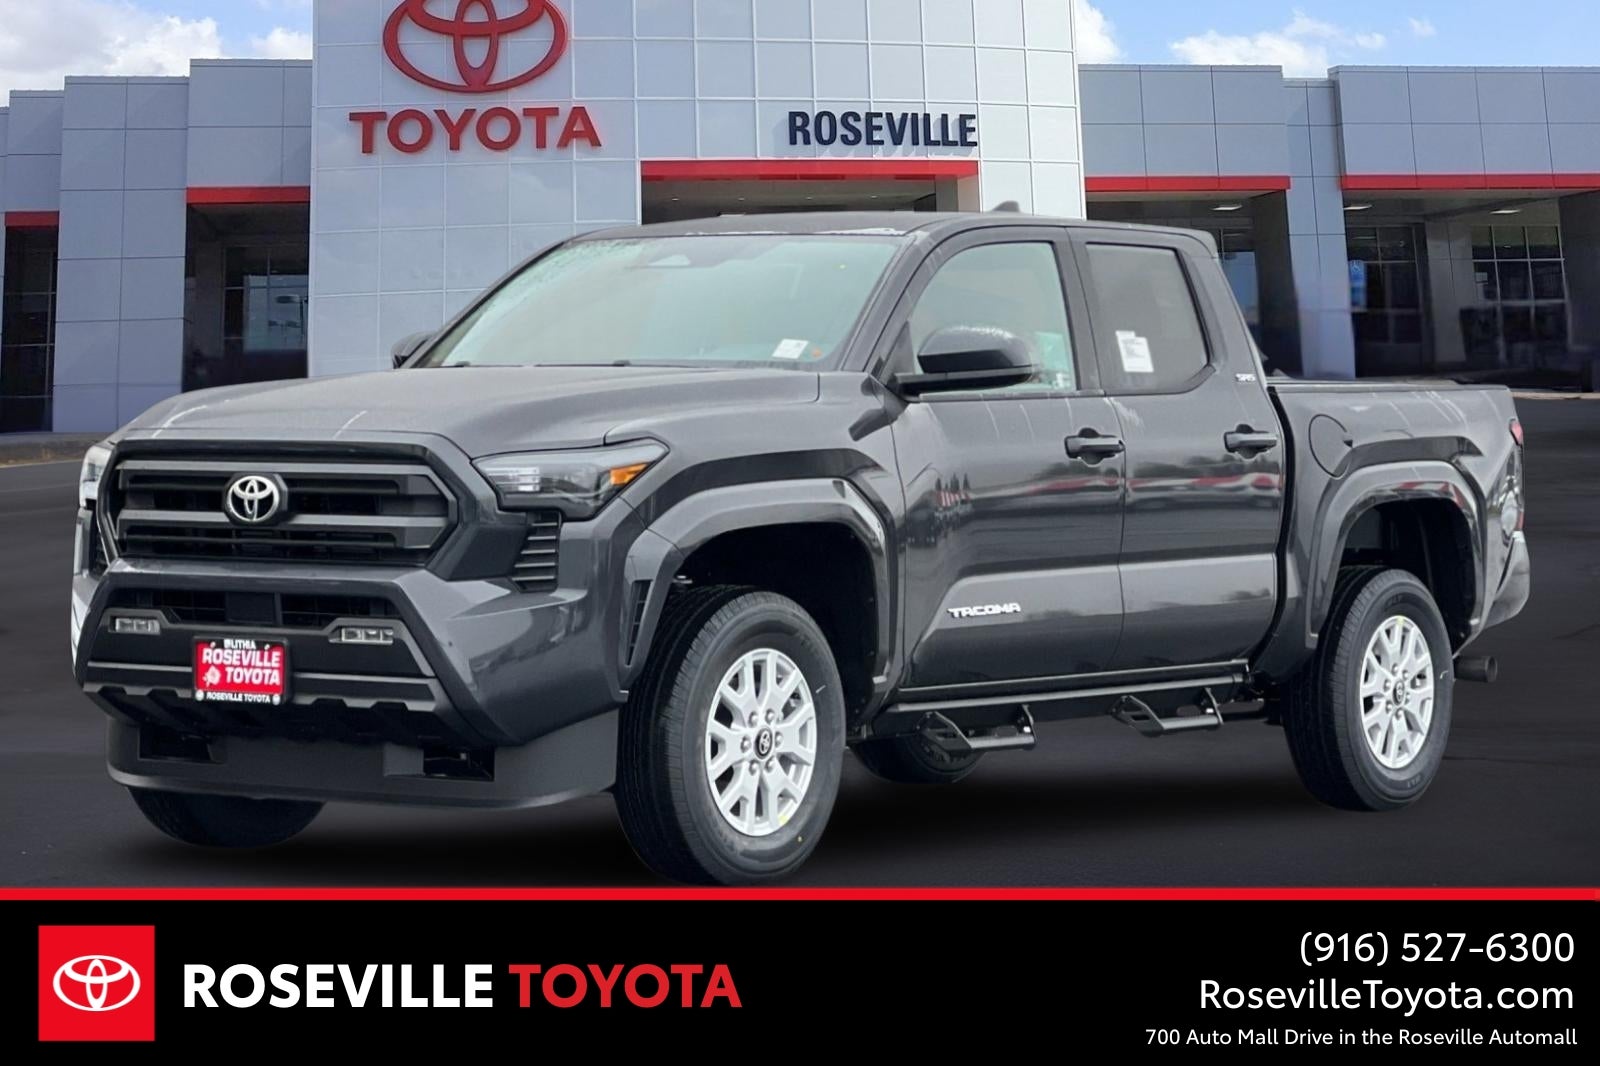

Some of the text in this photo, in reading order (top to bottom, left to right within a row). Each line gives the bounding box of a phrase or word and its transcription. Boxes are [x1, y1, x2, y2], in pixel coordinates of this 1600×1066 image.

[349, 106, 602, 154] TOYOTA
[788, 110, 978, 147] ROSEVILLE
[947, 602, 1021, 618] TACOMA
[202, 648, 281, 668] ROSEVILLE
[225, 666, 281, 686] TOYOTA
[206, 691, 271, 703] ROSEVILLE TOYOTA
